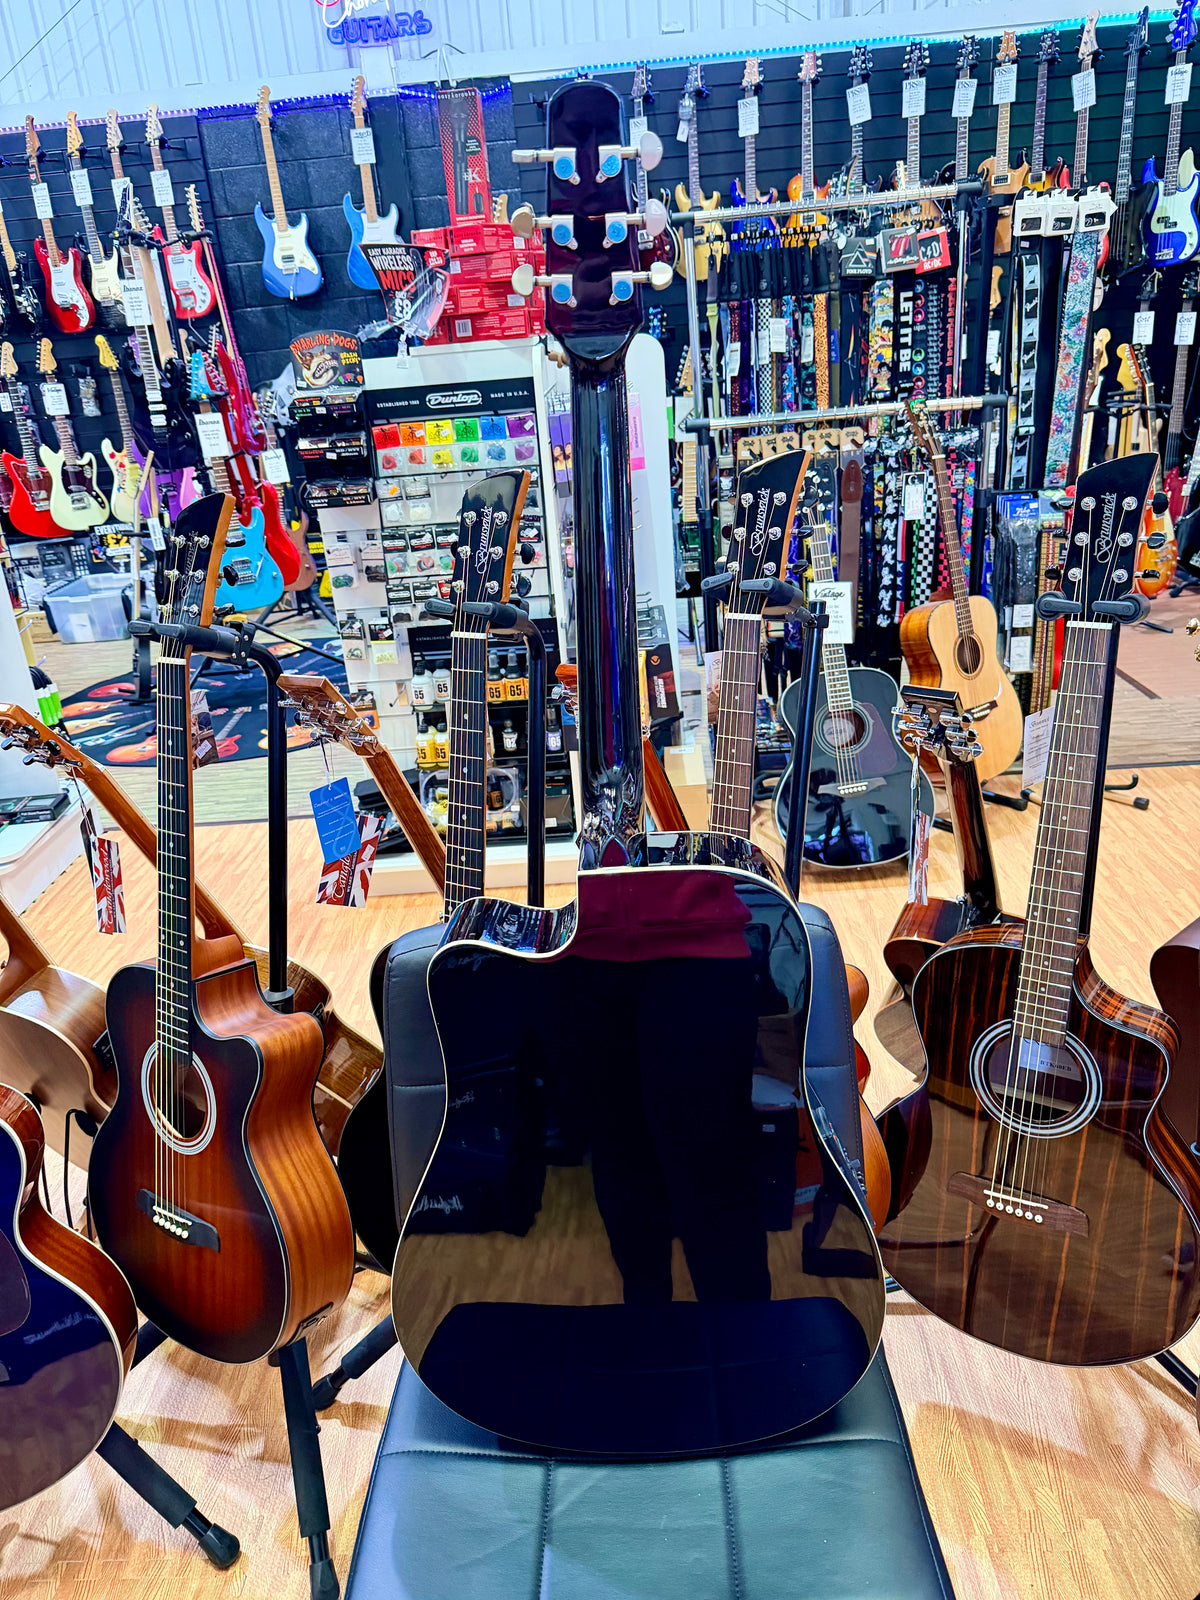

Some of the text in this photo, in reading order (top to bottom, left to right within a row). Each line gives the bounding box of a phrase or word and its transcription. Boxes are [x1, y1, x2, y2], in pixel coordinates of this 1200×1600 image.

[327, 10, 432, 45] GUITARS
[367, 247, 406, 256] EASY KARAOKE
[369, 255, 414, 271] WIRELESS
[378, 270, 416, 293] MICS
[900, 291, 914, 325] LET
[289, 333, 331, 354] SNARLING
[900, 327, 913, 347] IT
[899, 348, 912, 373] BE
[376, 400, 409, 408] ESTABLISHED
[429, 391, 479, 405] Dunlop
[1093, 492, 1117, 564] Brunswick
[813, 587, 846, 601] Vintage
[413, 690, 424, 700] 65
[437, 683, 448, 693] 65
[488, 687, 501, 698] 65
[509, 685, 522, 697] 65
[435, 747, 446, 759] 65
[331, 855, 352, 902] Tangle
